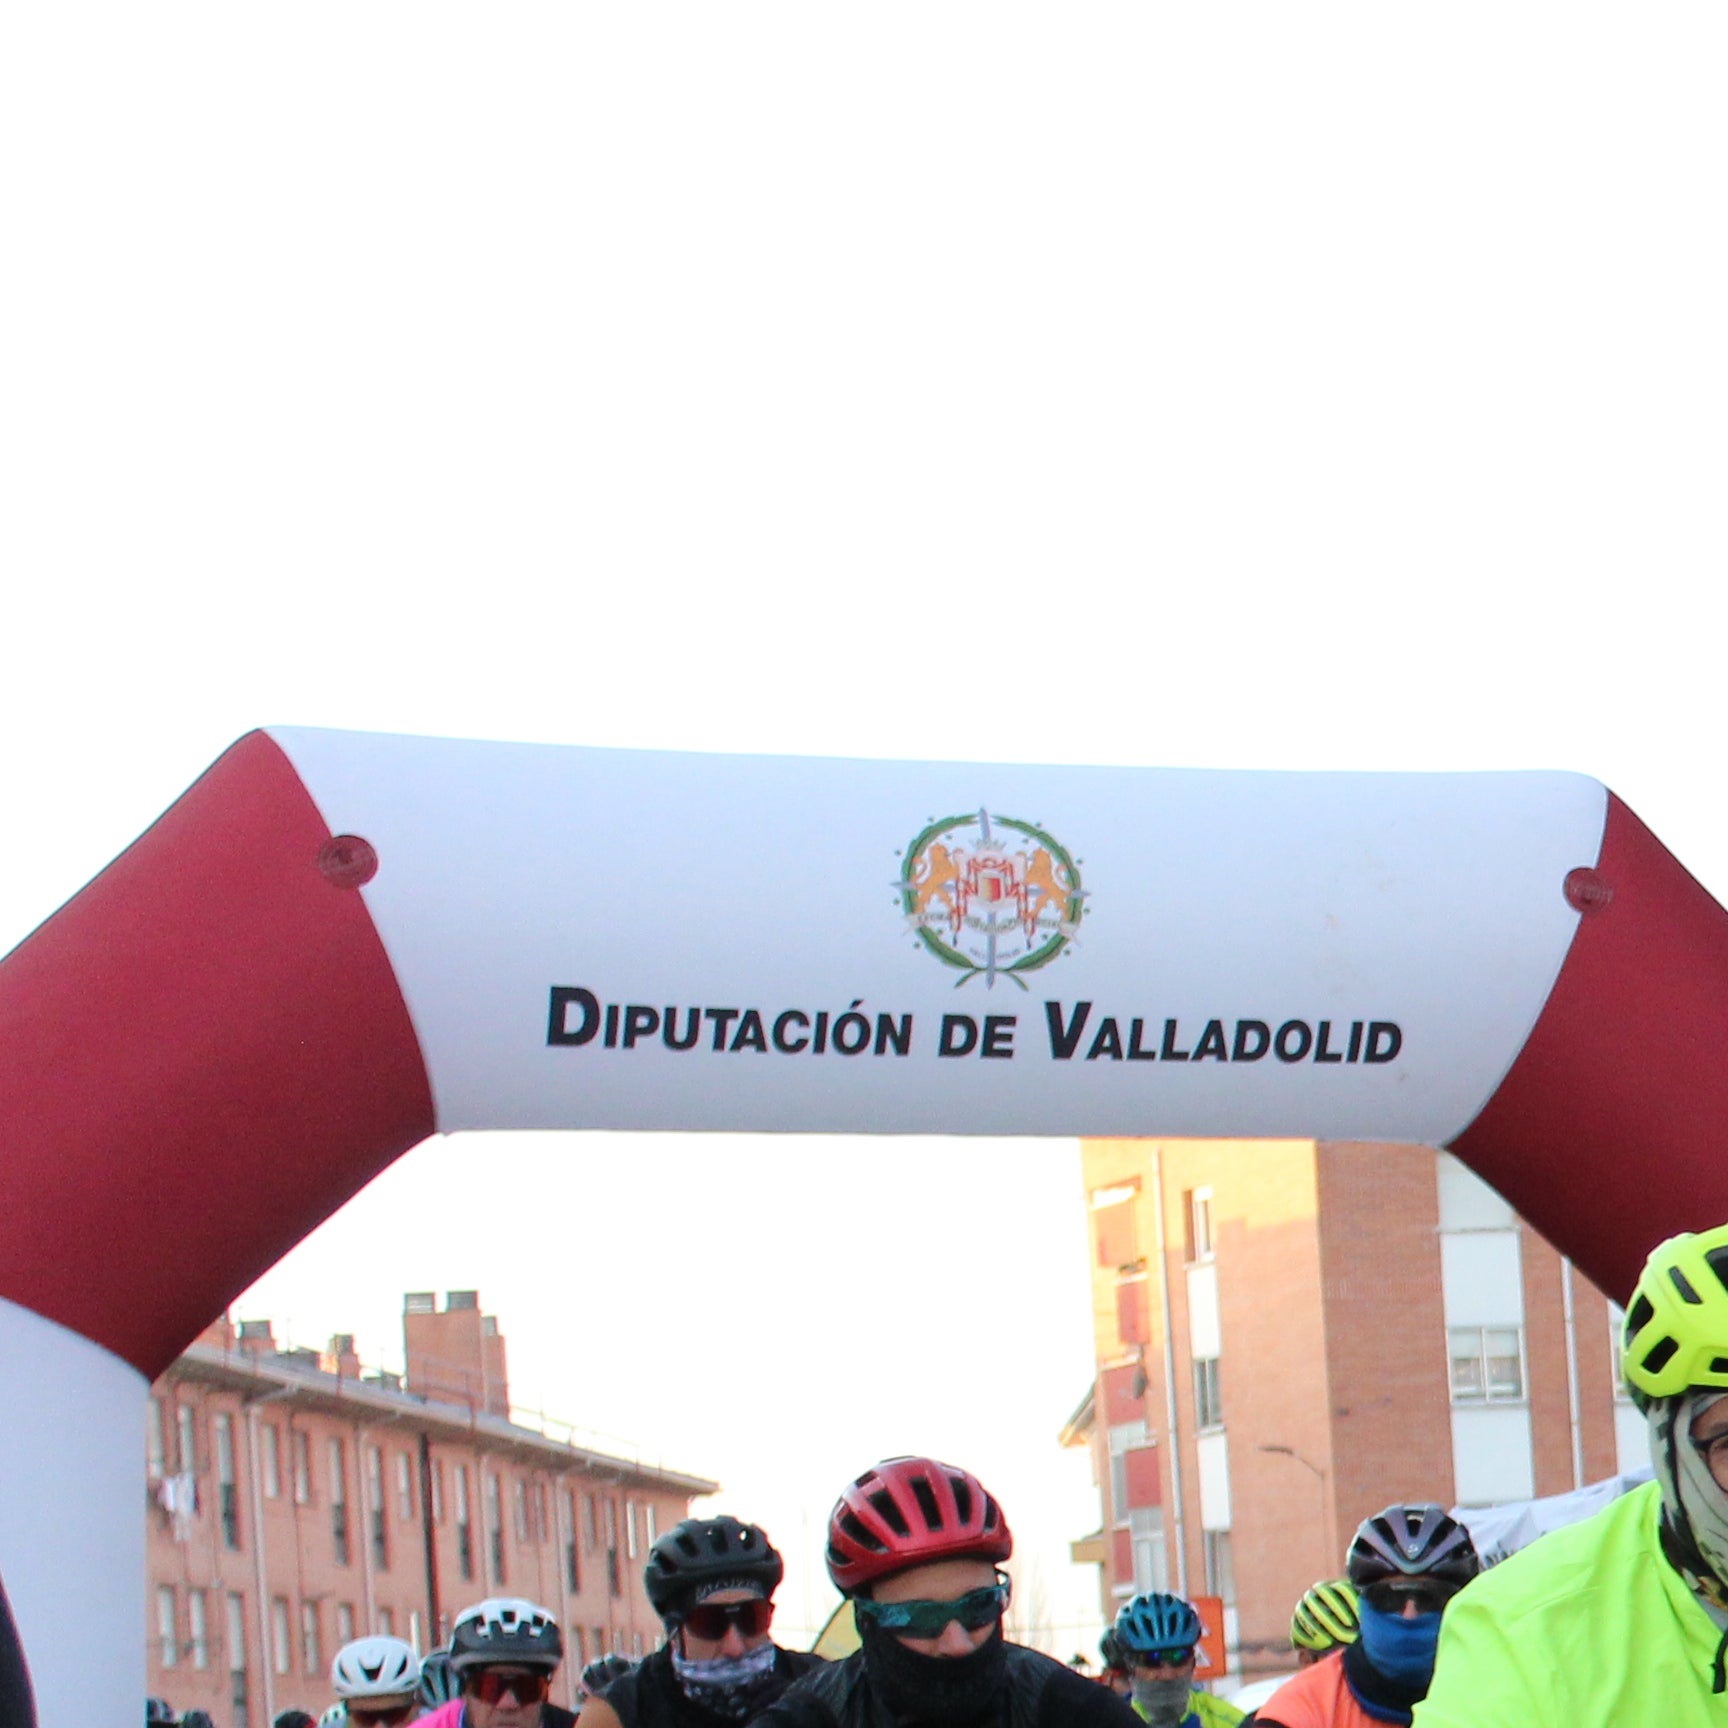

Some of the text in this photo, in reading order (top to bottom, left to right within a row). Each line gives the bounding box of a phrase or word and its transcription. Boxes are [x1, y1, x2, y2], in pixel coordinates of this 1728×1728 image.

[546, 985, 1404, 1064] DIPUTACIÓN DE VALLADOLID
